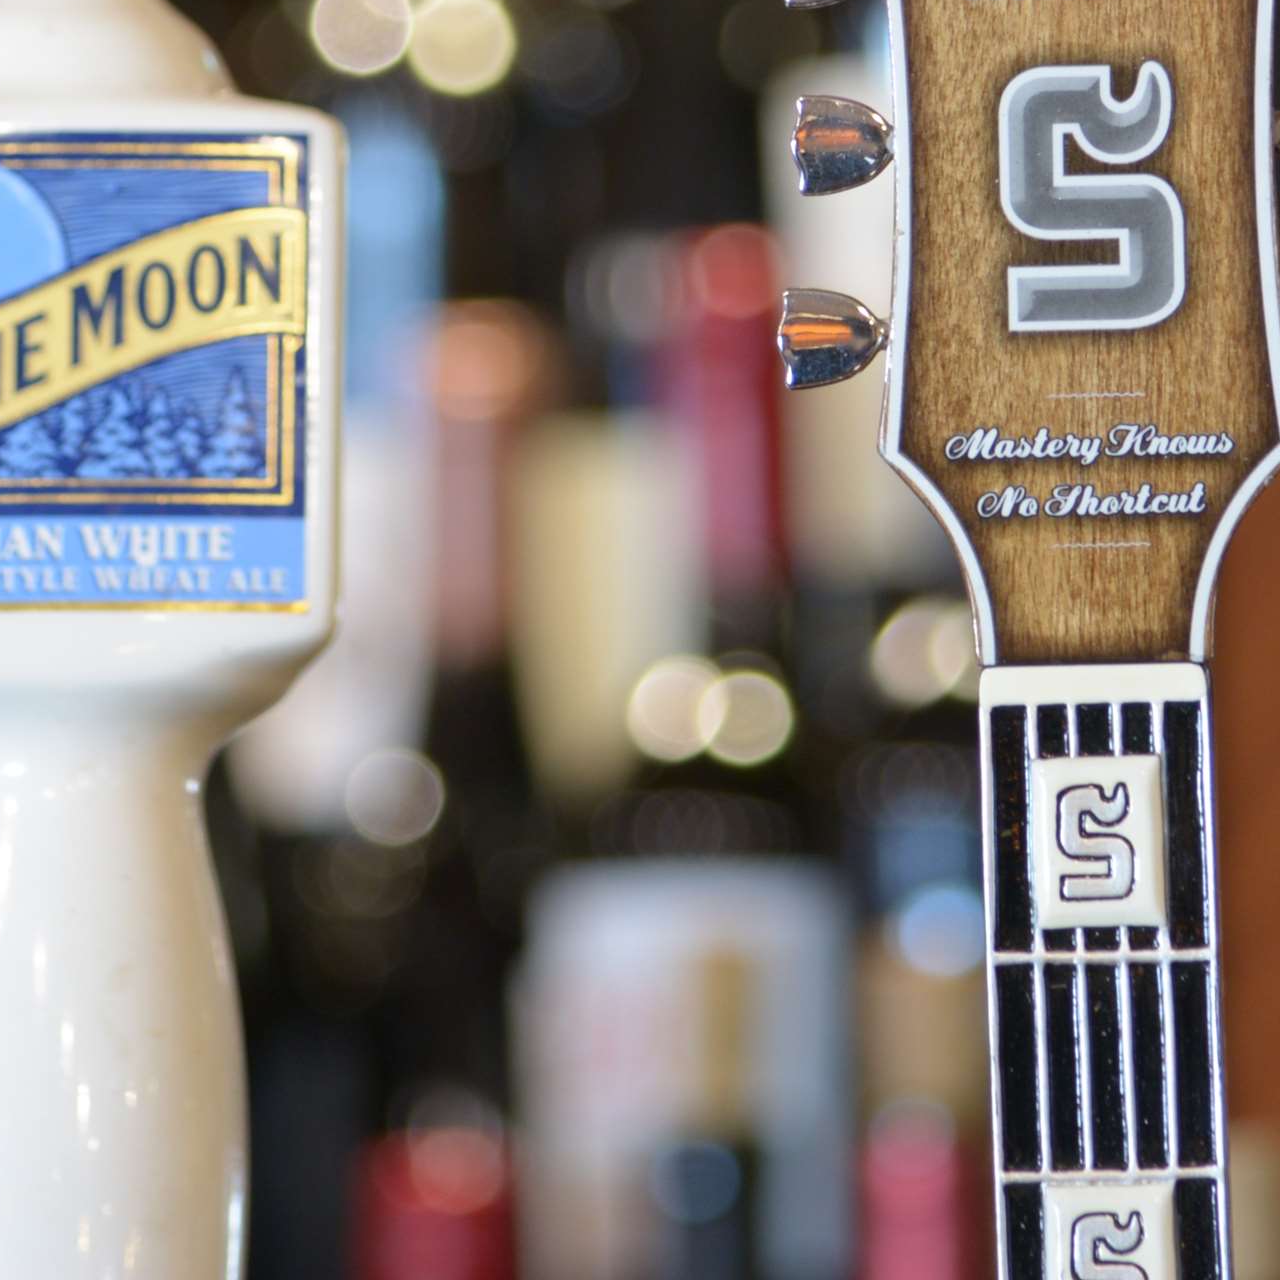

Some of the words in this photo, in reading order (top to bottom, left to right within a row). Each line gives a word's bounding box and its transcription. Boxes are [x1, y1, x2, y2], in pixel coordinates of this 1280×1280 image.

[998, 58, 1187, 333] S
[70, 231, 284, 368] MOON
[944, 426, 1104, 466] Mastery
[1105, 423, 1236, 457] Knows
[976, 485, 1039, 518] No
[1043, 481, 1207, 518] Shortcut
[80, 524, 237, 564] WHITE
[93, 564, 217, 596] WHEAT
[230, 566, 291, 595] ALE
